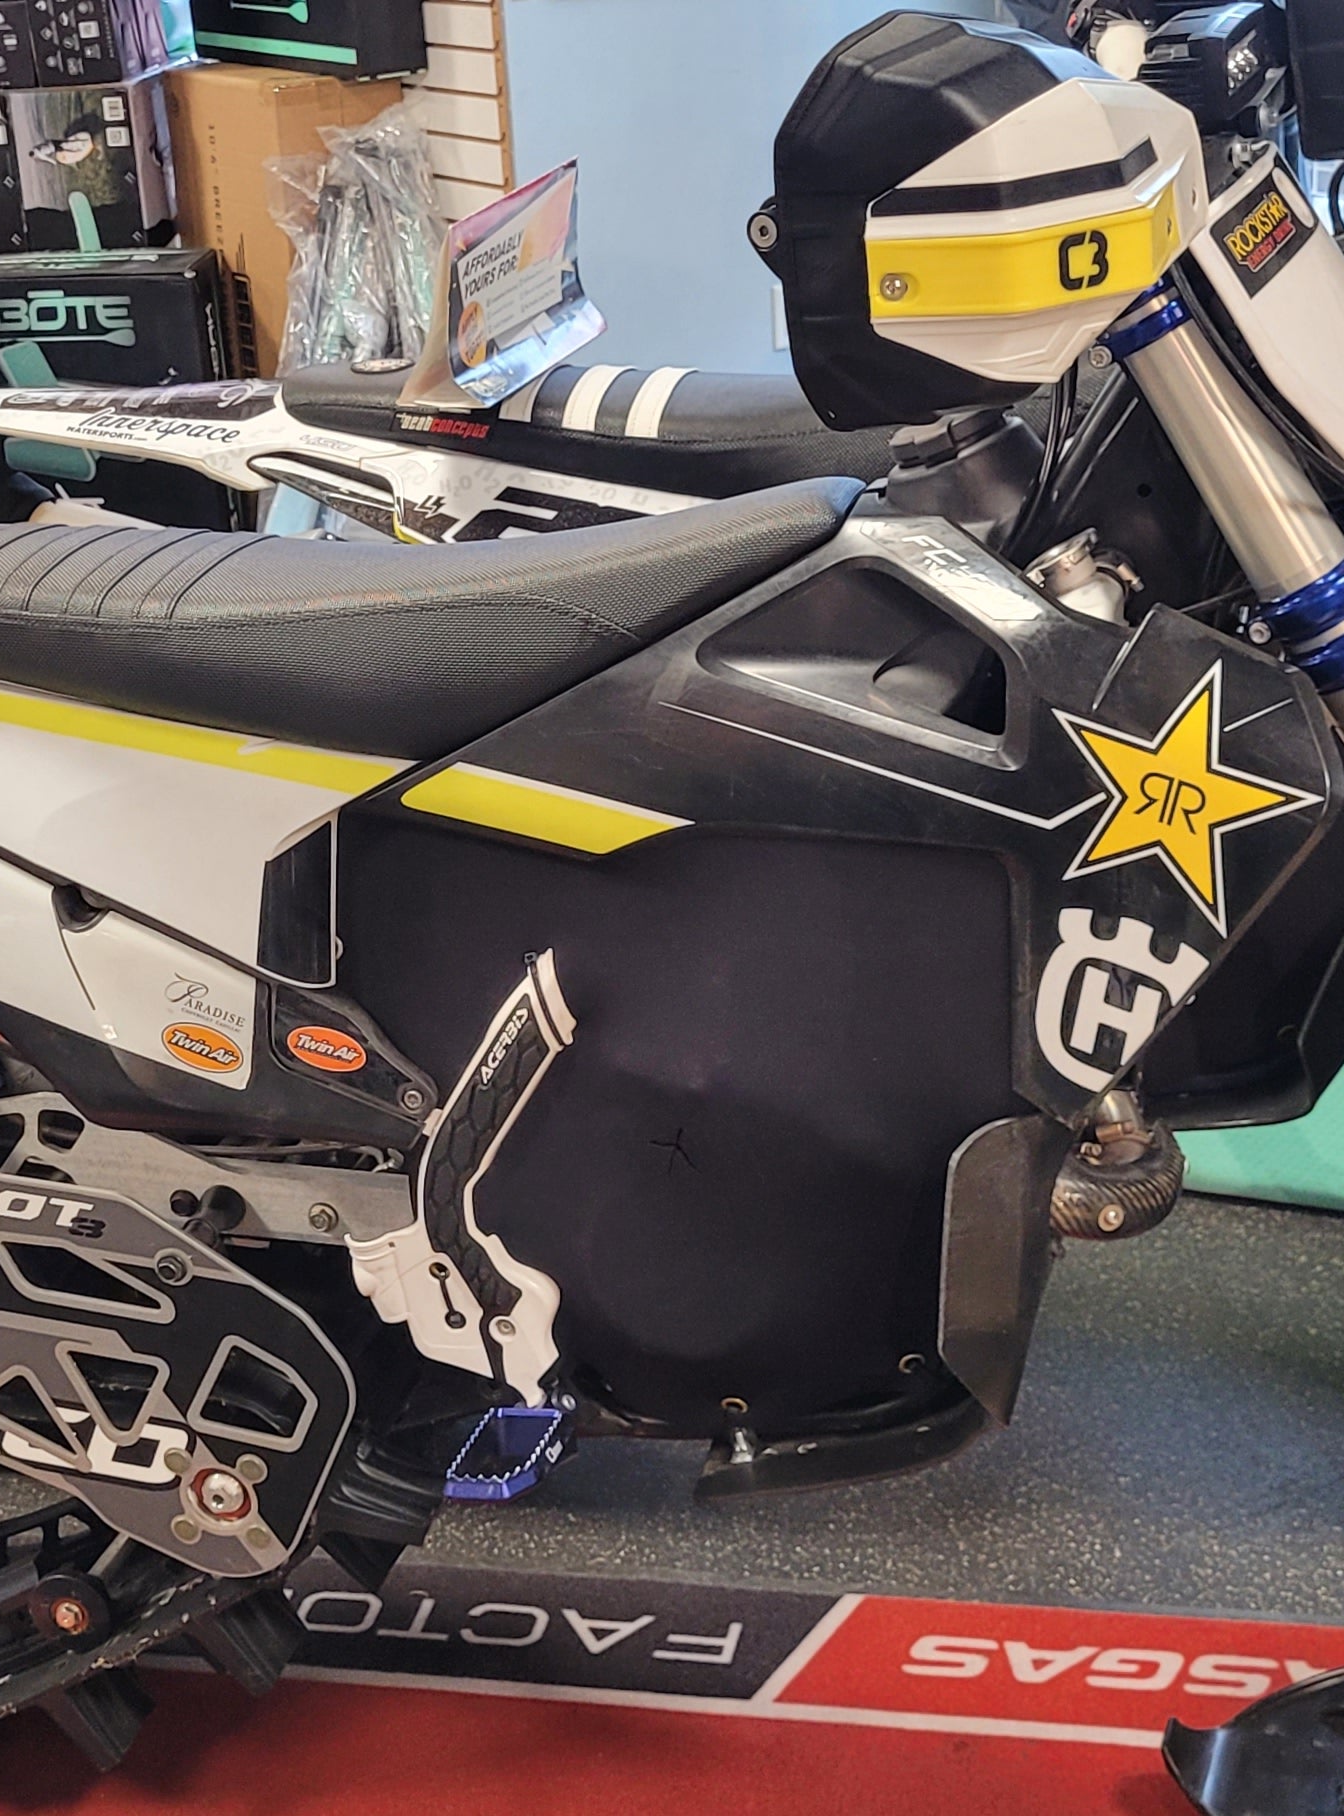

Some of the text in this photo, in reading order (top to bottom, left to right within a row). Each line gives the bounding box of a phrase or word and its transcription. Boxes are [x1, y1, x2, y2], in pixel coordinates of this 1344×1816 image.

[1226, 191, 1289, 262] ROCKSTAR
[1057, 230, 1110, 290] C3
[463, 269, 496, 300] YOURS
[78, 406, 242, 444] Innerspace
[169, 1029, 239, 1065] Twin Air
[296, 1033, 362, 1063] Twin Air
[288, 1588, 743, 1666] FACTO
